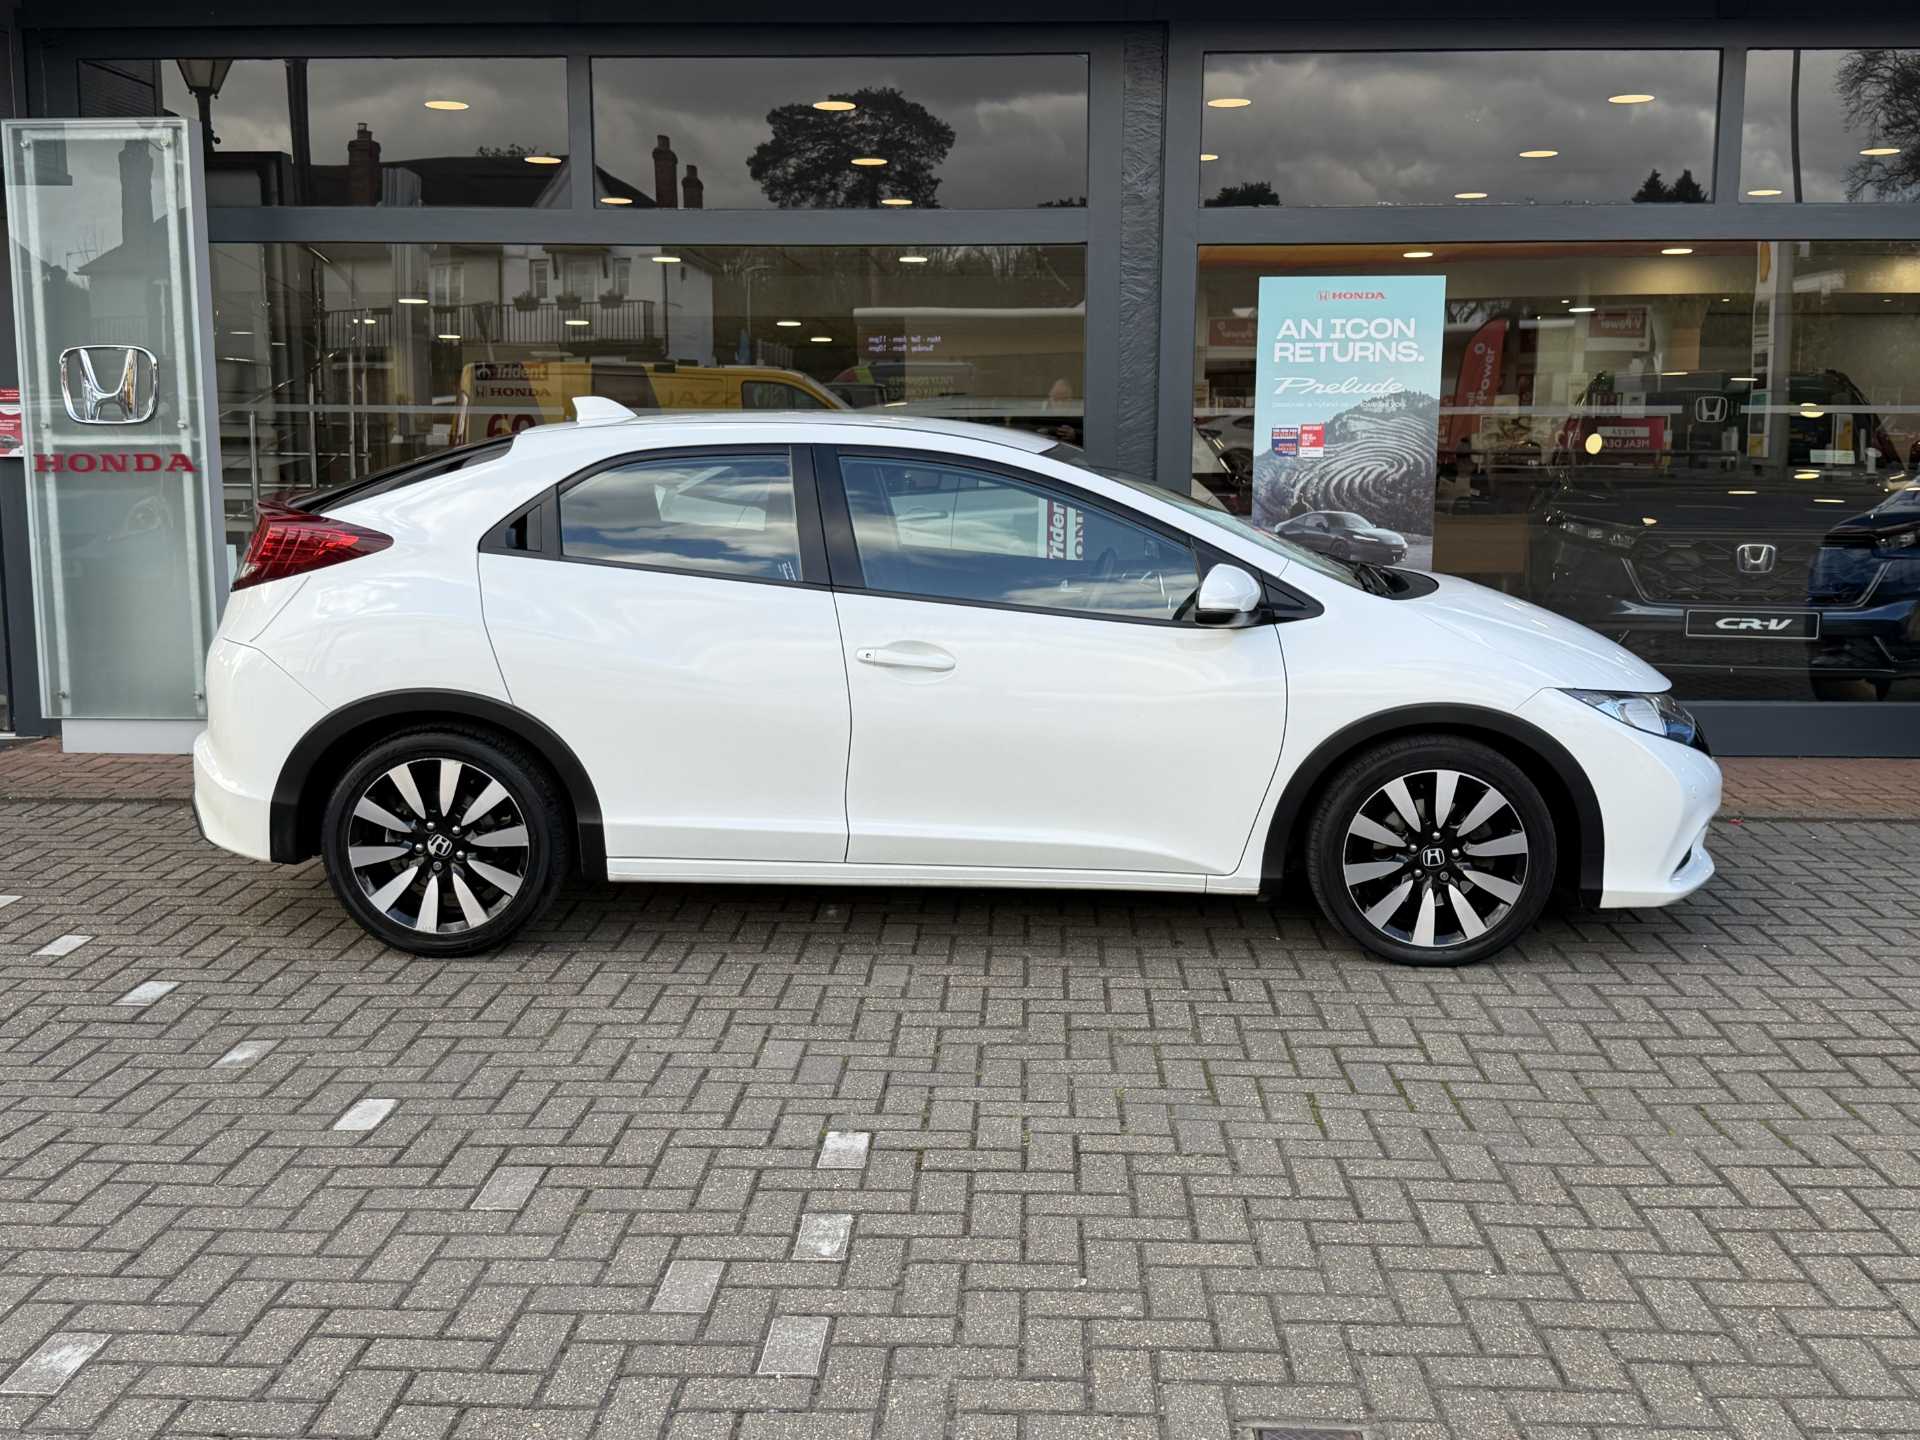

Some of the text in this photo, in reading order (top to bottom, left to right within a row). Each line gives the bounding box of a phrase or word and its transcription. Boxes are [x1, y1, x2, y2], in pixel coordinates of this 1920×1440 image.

[1332, 291, 1387, 300] HONDA
[1277, 318, 1416, 339] AN ICON
[1274, 341, 1425, 363] RETURNS.
[495, 364, 548, 379] Trident
[489, 387, 552, 397] HONDA
[1274, 376, 1403, 395] Prelude
[33, 453, 198, 474] HONDA
[1049, 501, 1066, 559] riden
[1715, 617, 1793, 631] CR-V
